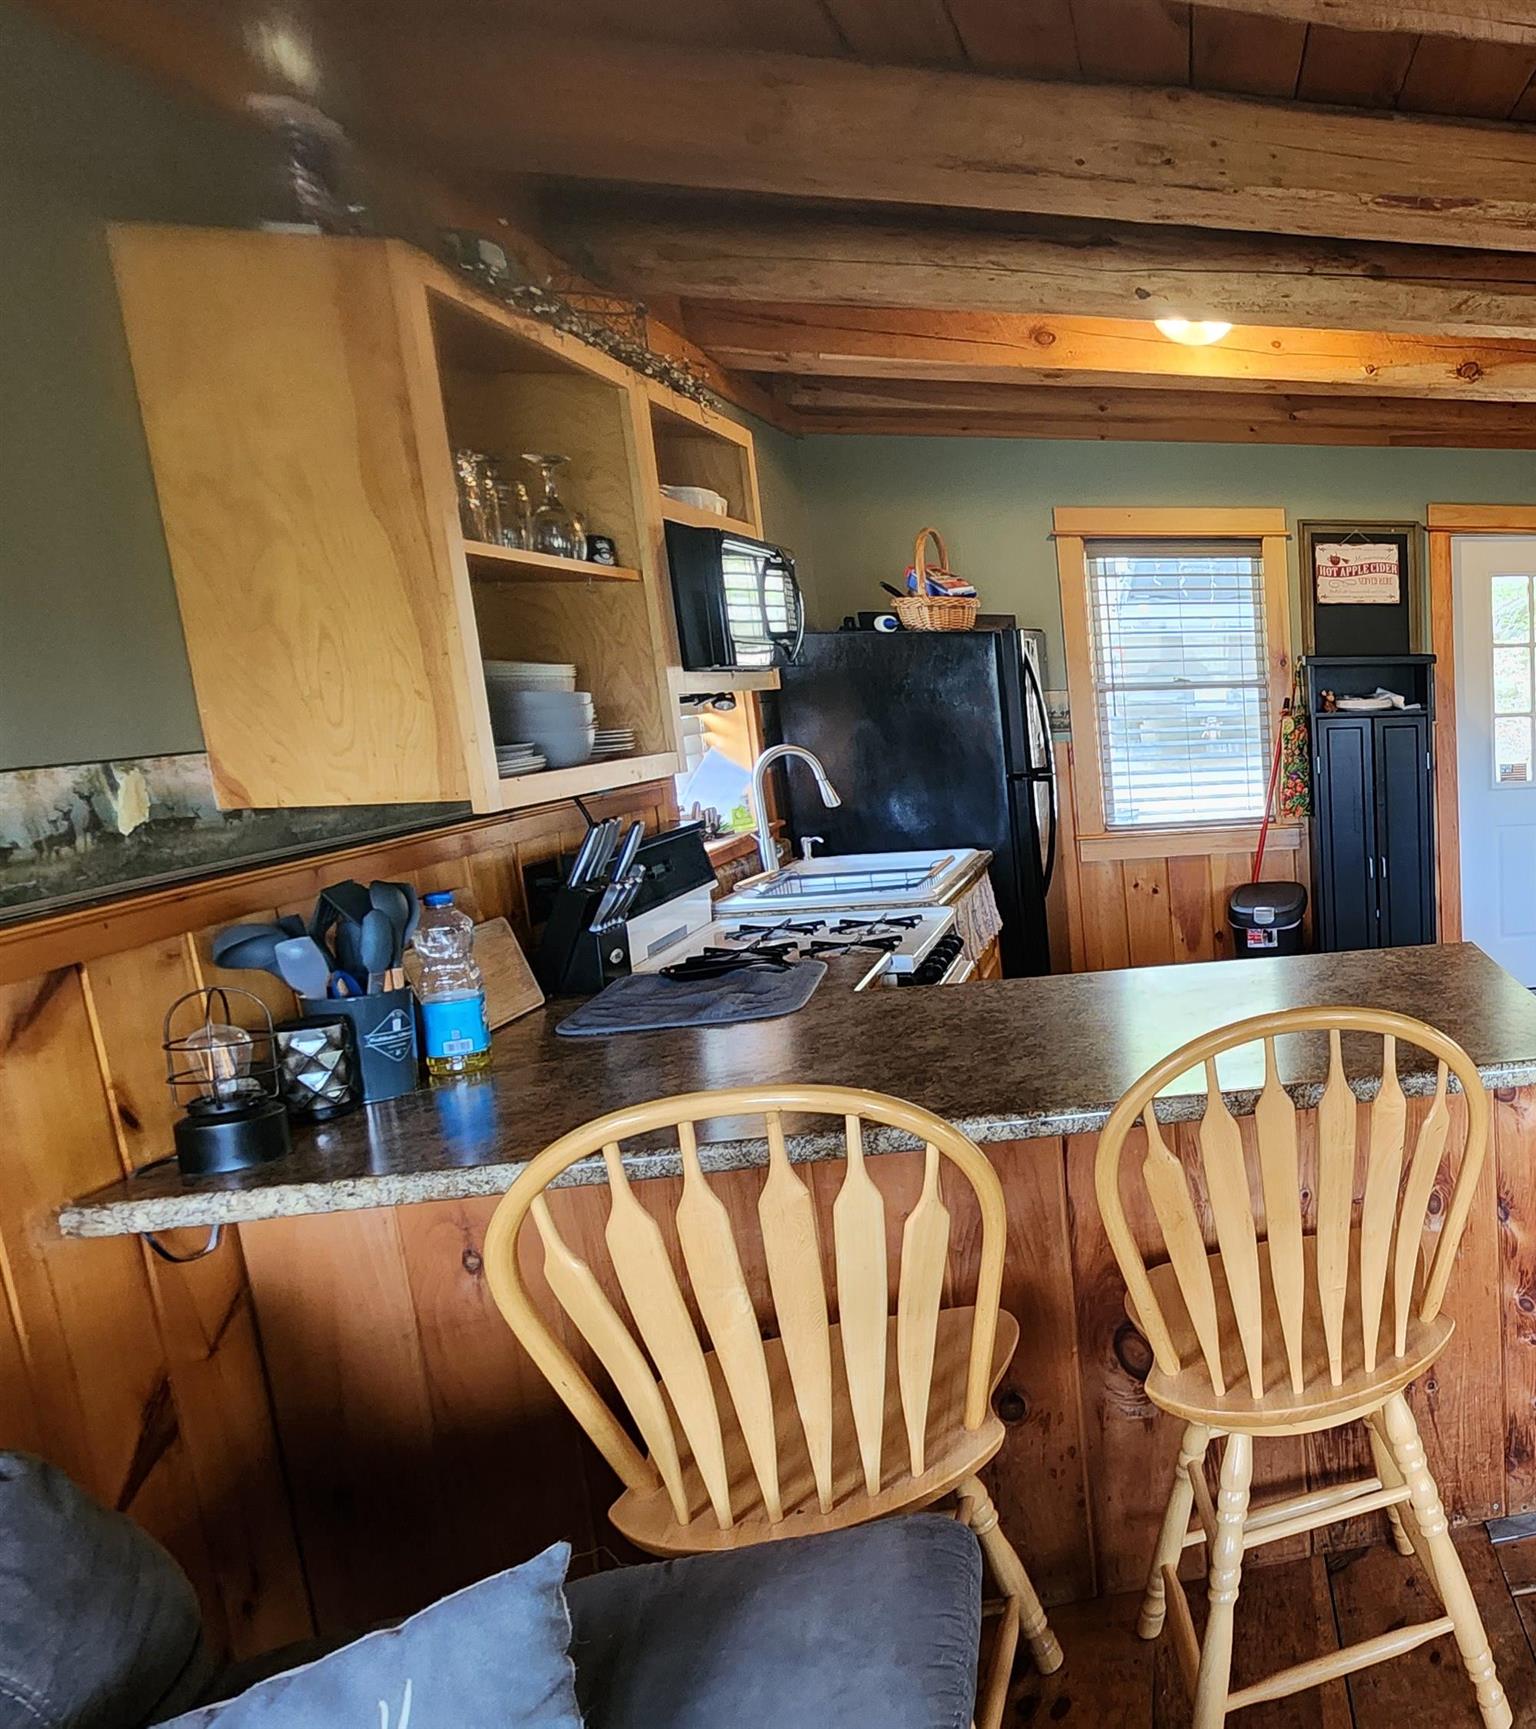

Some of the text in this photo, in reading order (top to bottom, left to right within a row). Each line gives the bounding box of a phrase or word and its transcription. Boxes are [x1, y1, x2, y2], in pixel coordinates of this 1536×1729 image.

[1320, 563, 1397, 577] HOT APPLE CIDER
